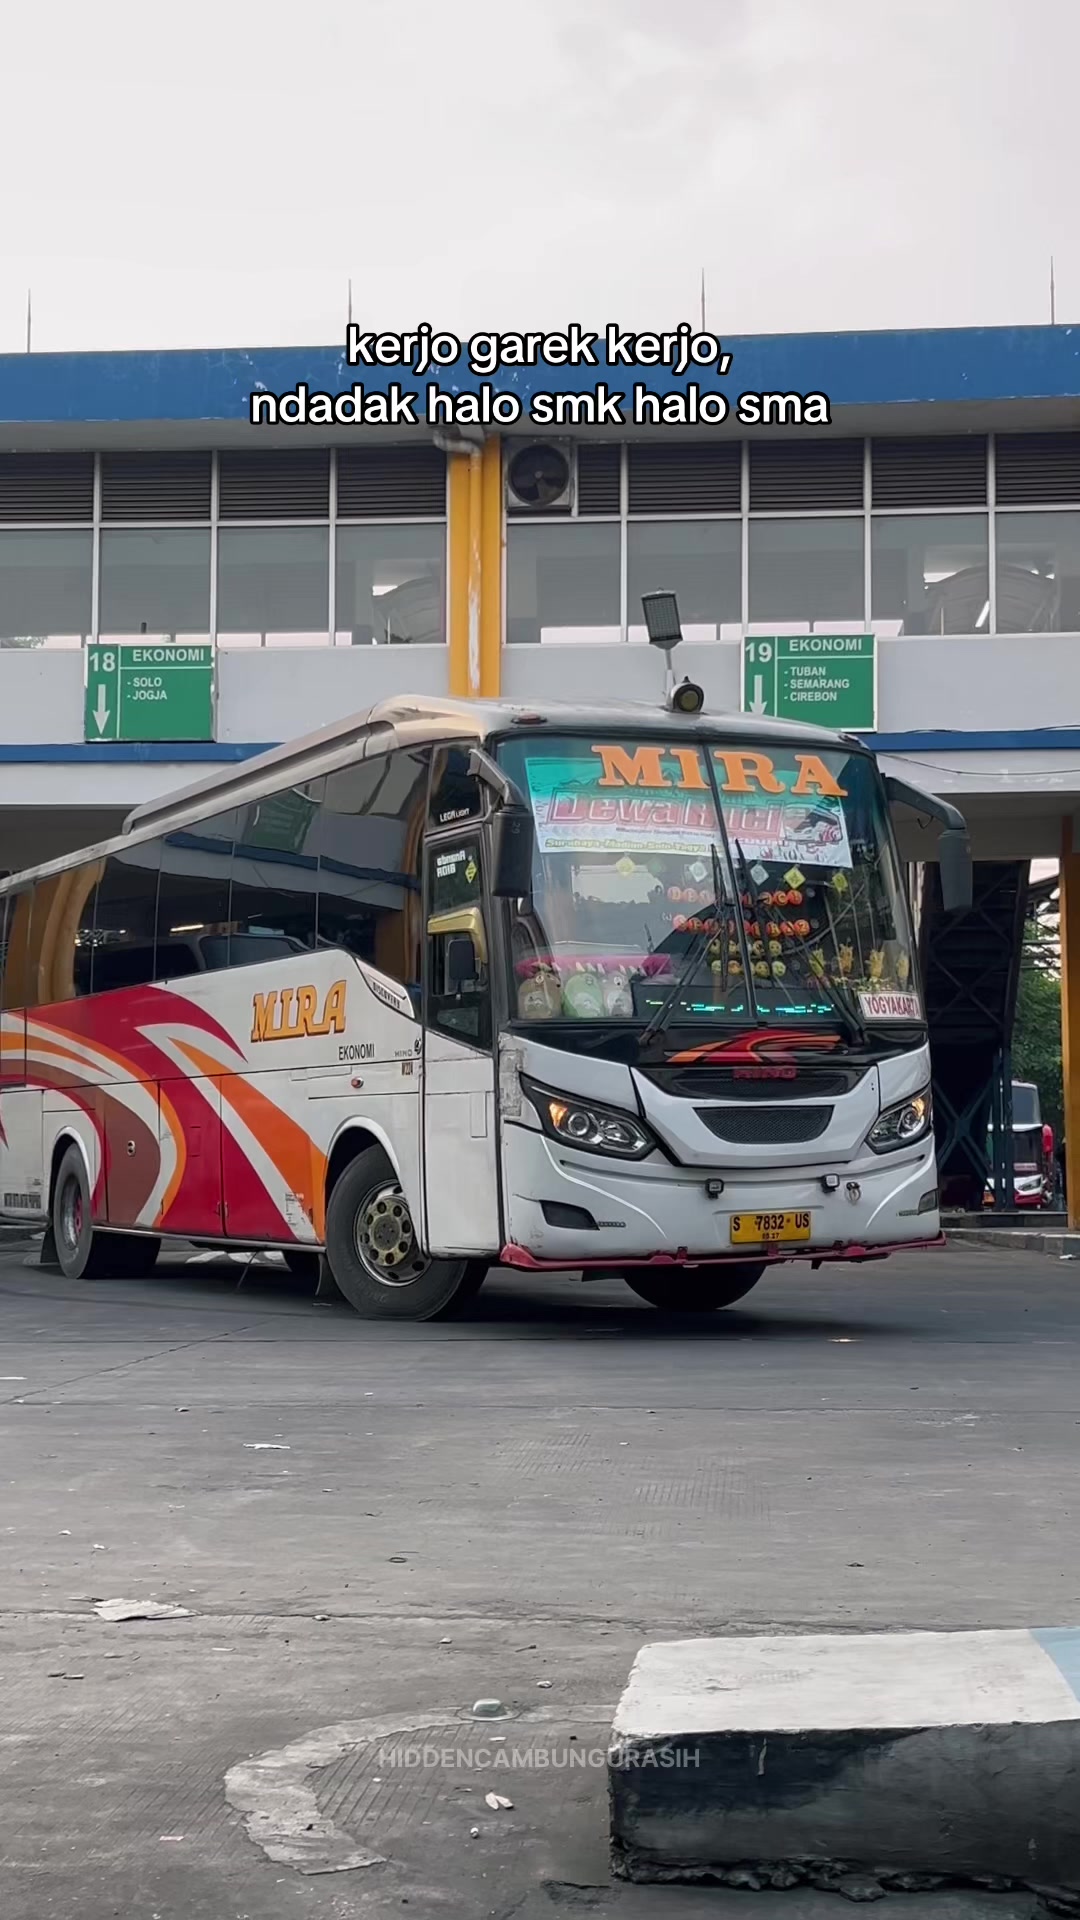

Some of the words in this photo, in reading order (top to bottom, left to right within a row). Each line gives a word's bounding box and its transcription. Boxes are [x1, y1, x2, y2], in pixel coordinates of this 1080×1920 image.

[745, 642, 772, 662] 19
[789, 639, 862, 651] EKONOMI
[90, 652, 115, 672] 18
[133, 649, 204, 661] EKONOMI
[591, 745, 848, 796] MIRA
[251, 979, 347, 1043] MIRA
[338, 1043, 375, 1060] EKONOMI
[733, 1216, 741, 1231] S
[755, 1214, 784, 1231] 7832
[795, 1213, 809, 1228] US
